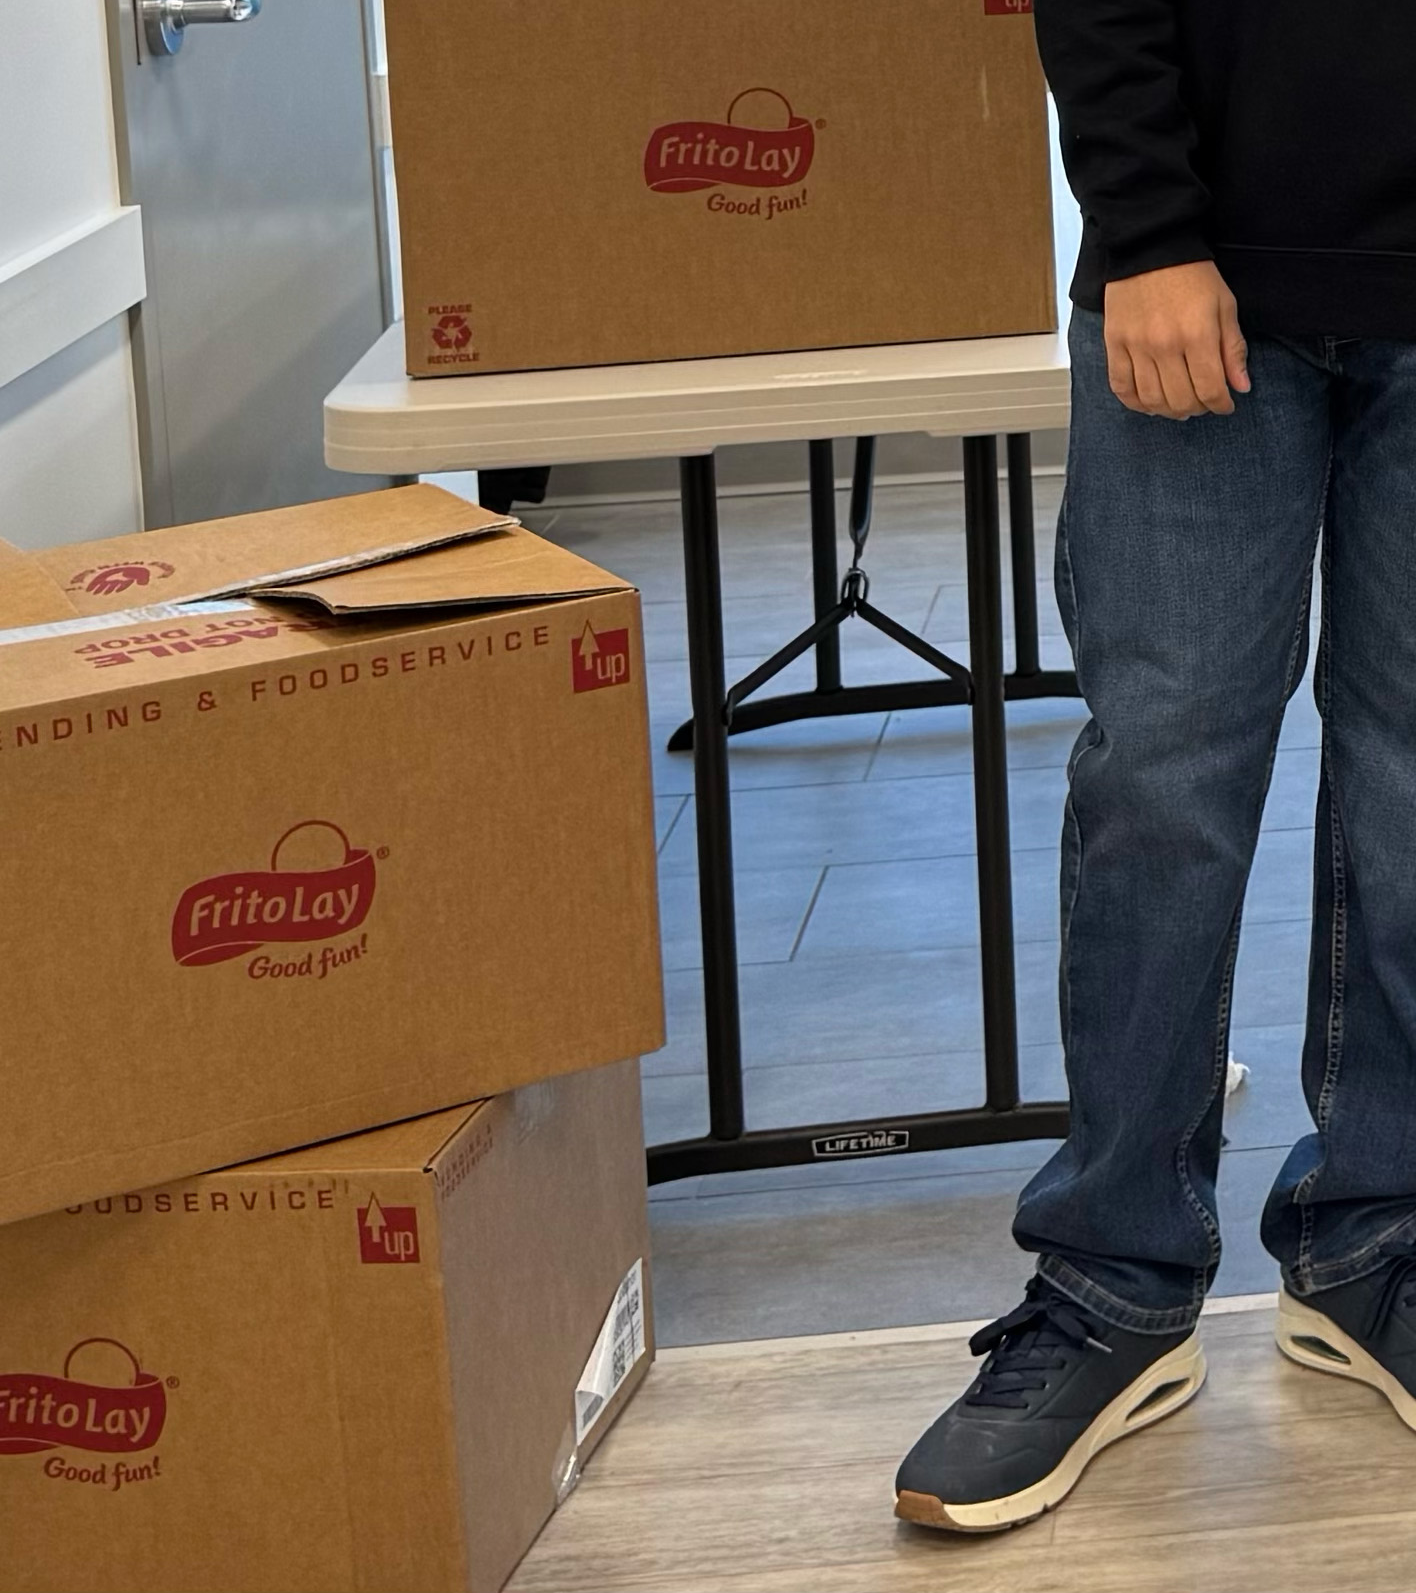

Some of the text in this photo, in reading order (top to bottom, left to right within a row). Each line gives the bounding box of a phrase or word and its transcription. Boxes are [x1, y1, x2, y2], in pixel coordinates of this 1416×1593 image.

[706, 189, 809, 221] Good fun!
[428, 304, 472, 315] PLEASE
[427, 352, 480, 364] RECYCLE
[74, 628, 191, 655] DROP
[84, 613, 336, 670] RAGILE
[597, 651, 626, 686] up
[0, 625, 551, 752] NDING & FOODSERVICE
[247, 933, 369, 980] Good fun!
[825, 1133, 896, 1152] LIFETIME
[384, 1230, 415, 1261] up
[44, 1455, 162, 1492] Good fun!
